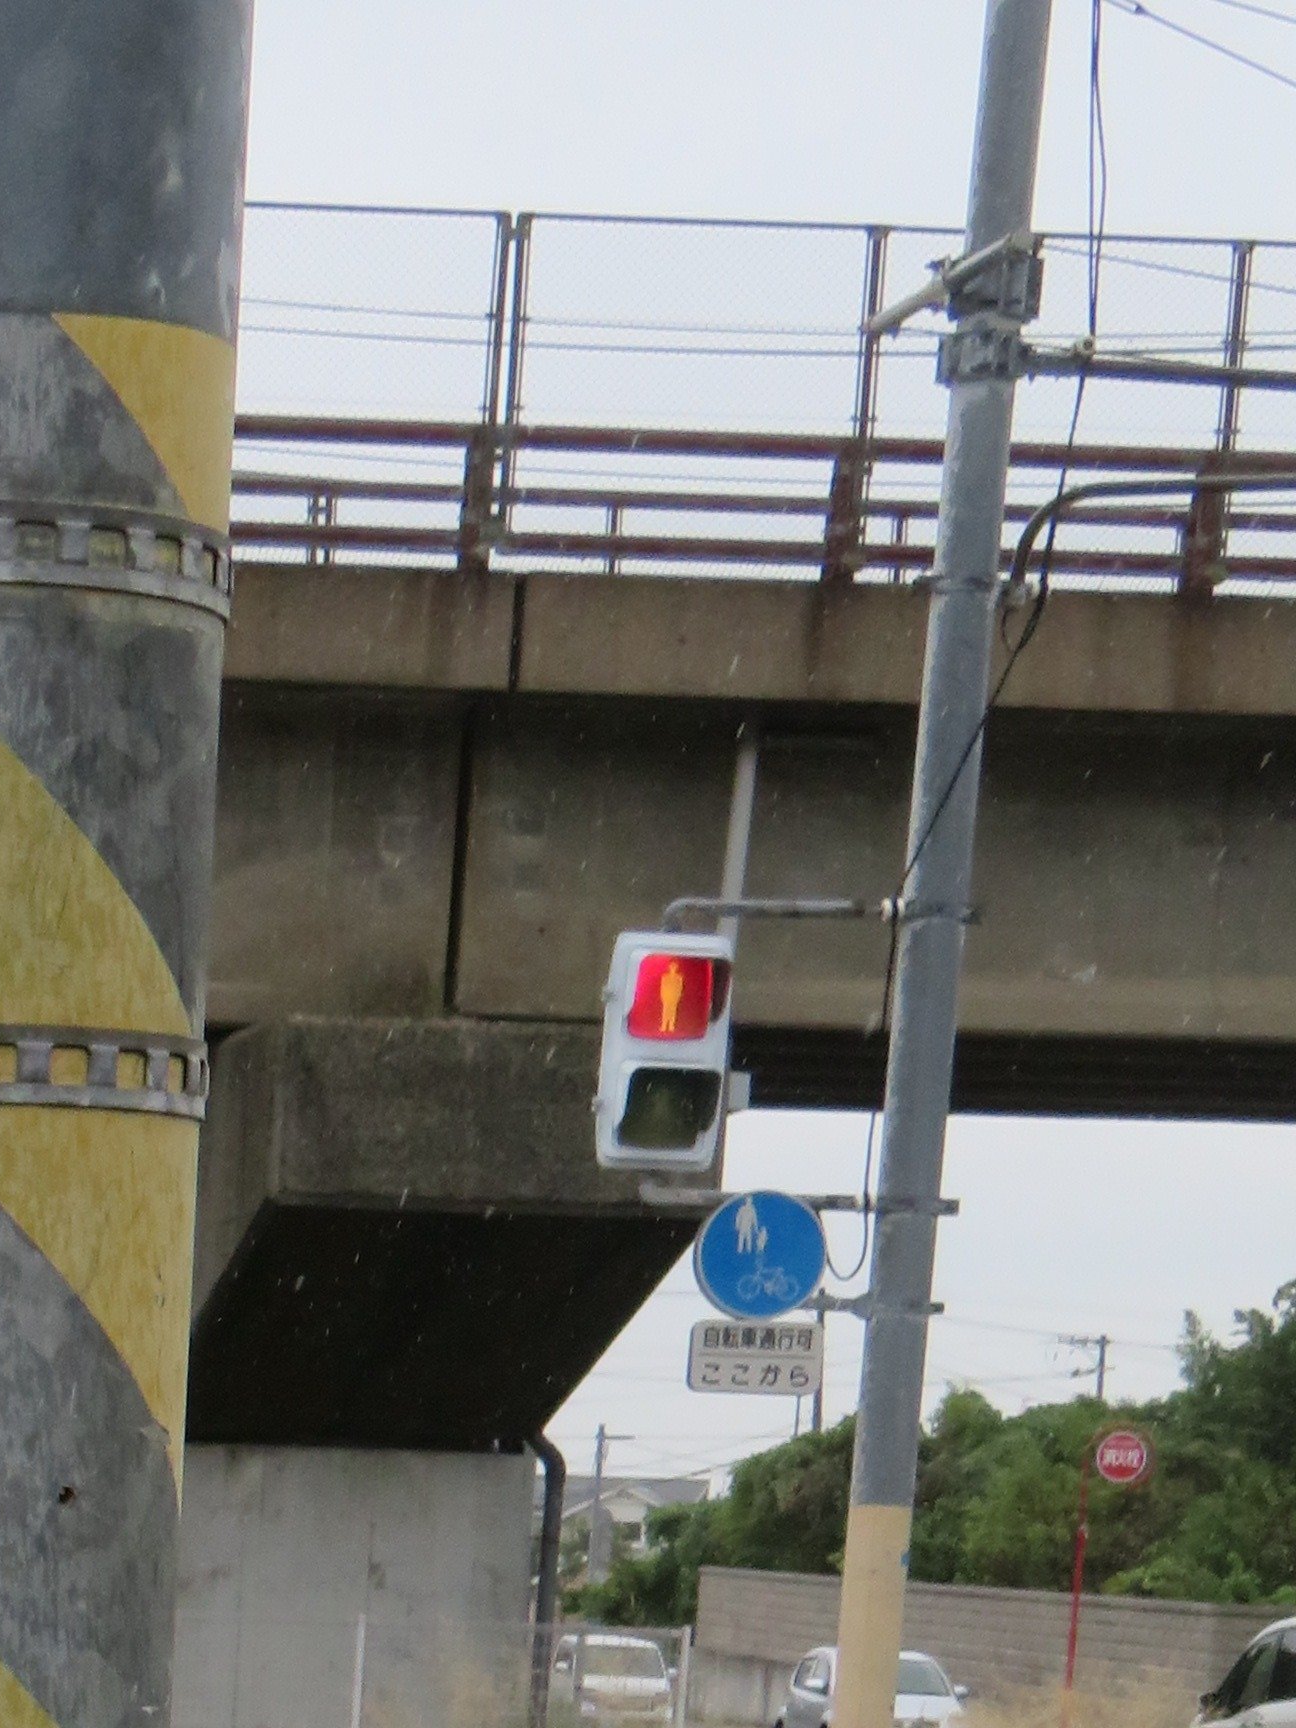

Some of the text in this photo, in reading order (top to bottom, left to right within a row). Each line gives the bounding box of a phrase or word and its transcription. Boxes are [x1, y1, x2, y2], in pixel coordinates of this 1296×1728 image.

[704, 1327, 812, 1351] 自転車通行可
[702, 1363, 809, 1387] ここから
